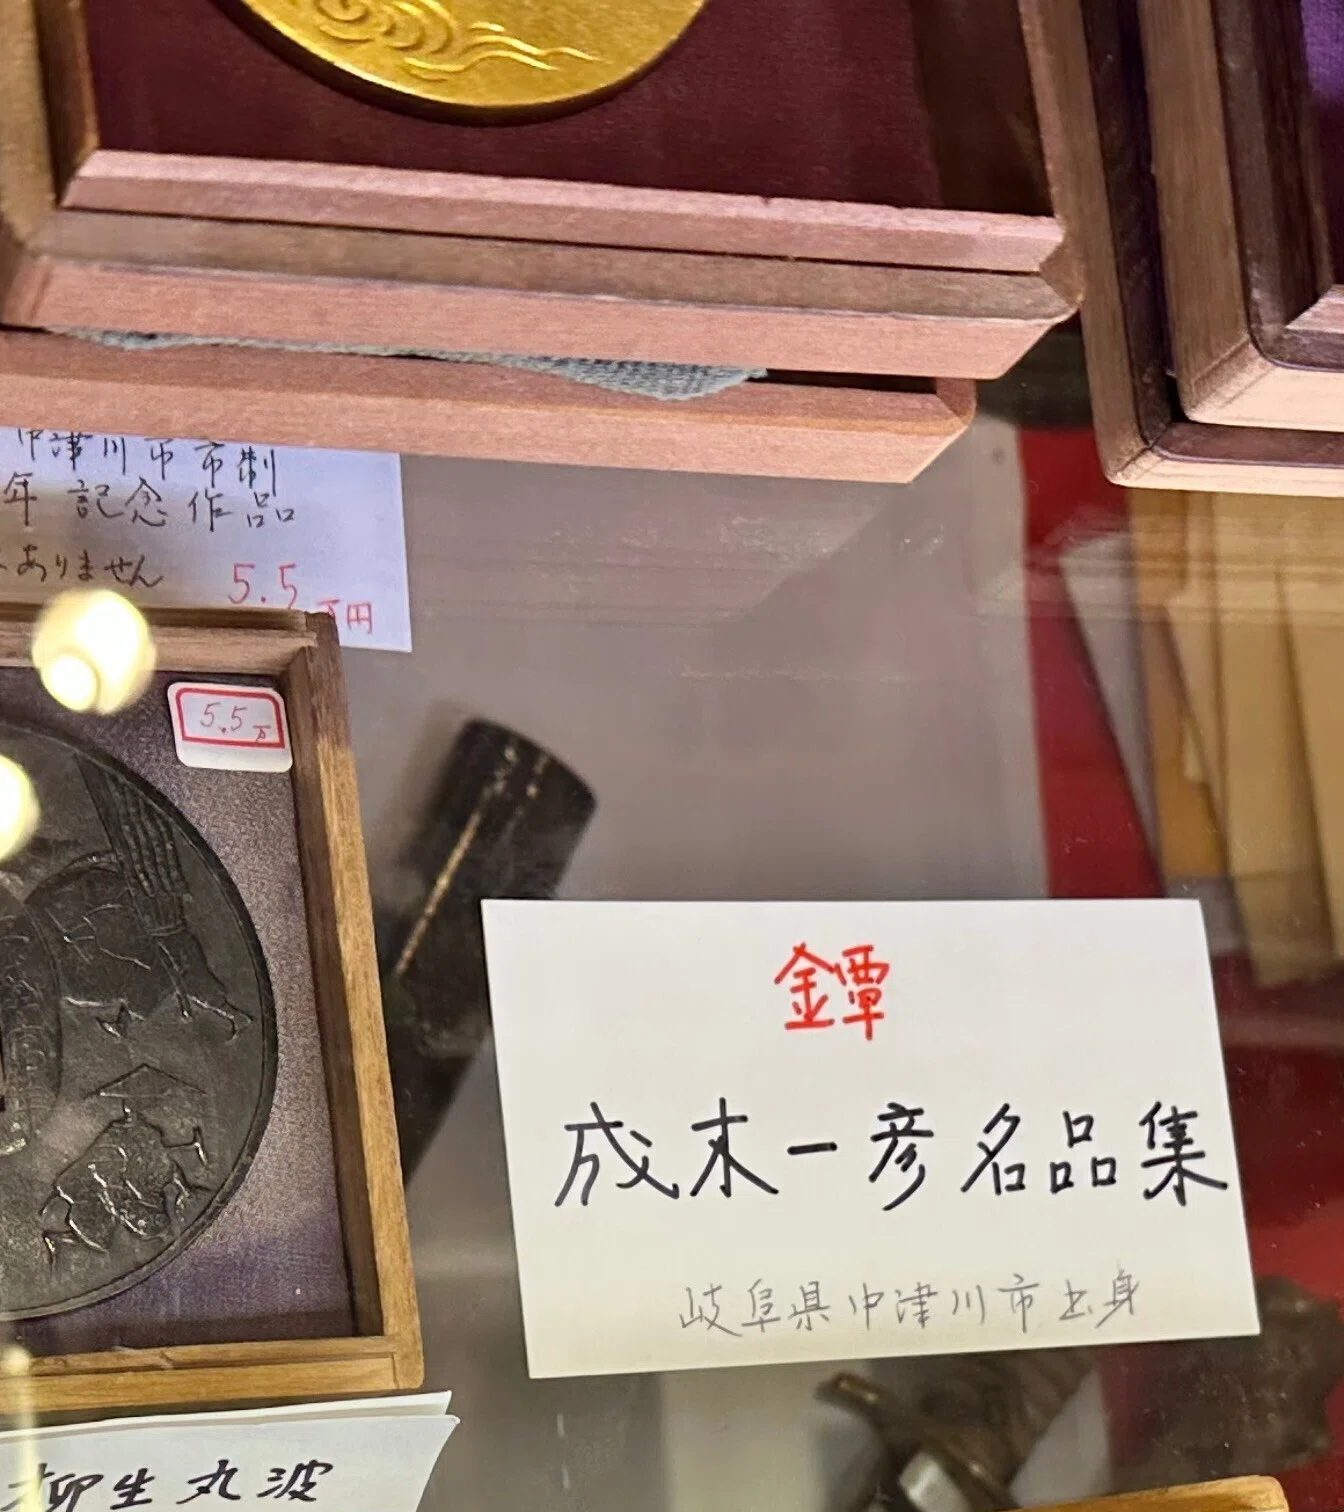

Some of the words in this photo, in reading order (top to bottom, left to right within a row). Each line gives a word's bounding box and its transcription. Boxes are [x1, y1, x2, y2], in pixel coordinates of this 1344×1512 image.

[199, 701, 272, 743] 5.5万
[553, 1096, 1229, 1211] 成木一彦名品集
[678, 1267, 1143, 1337] 岐阜県中津川市出身
